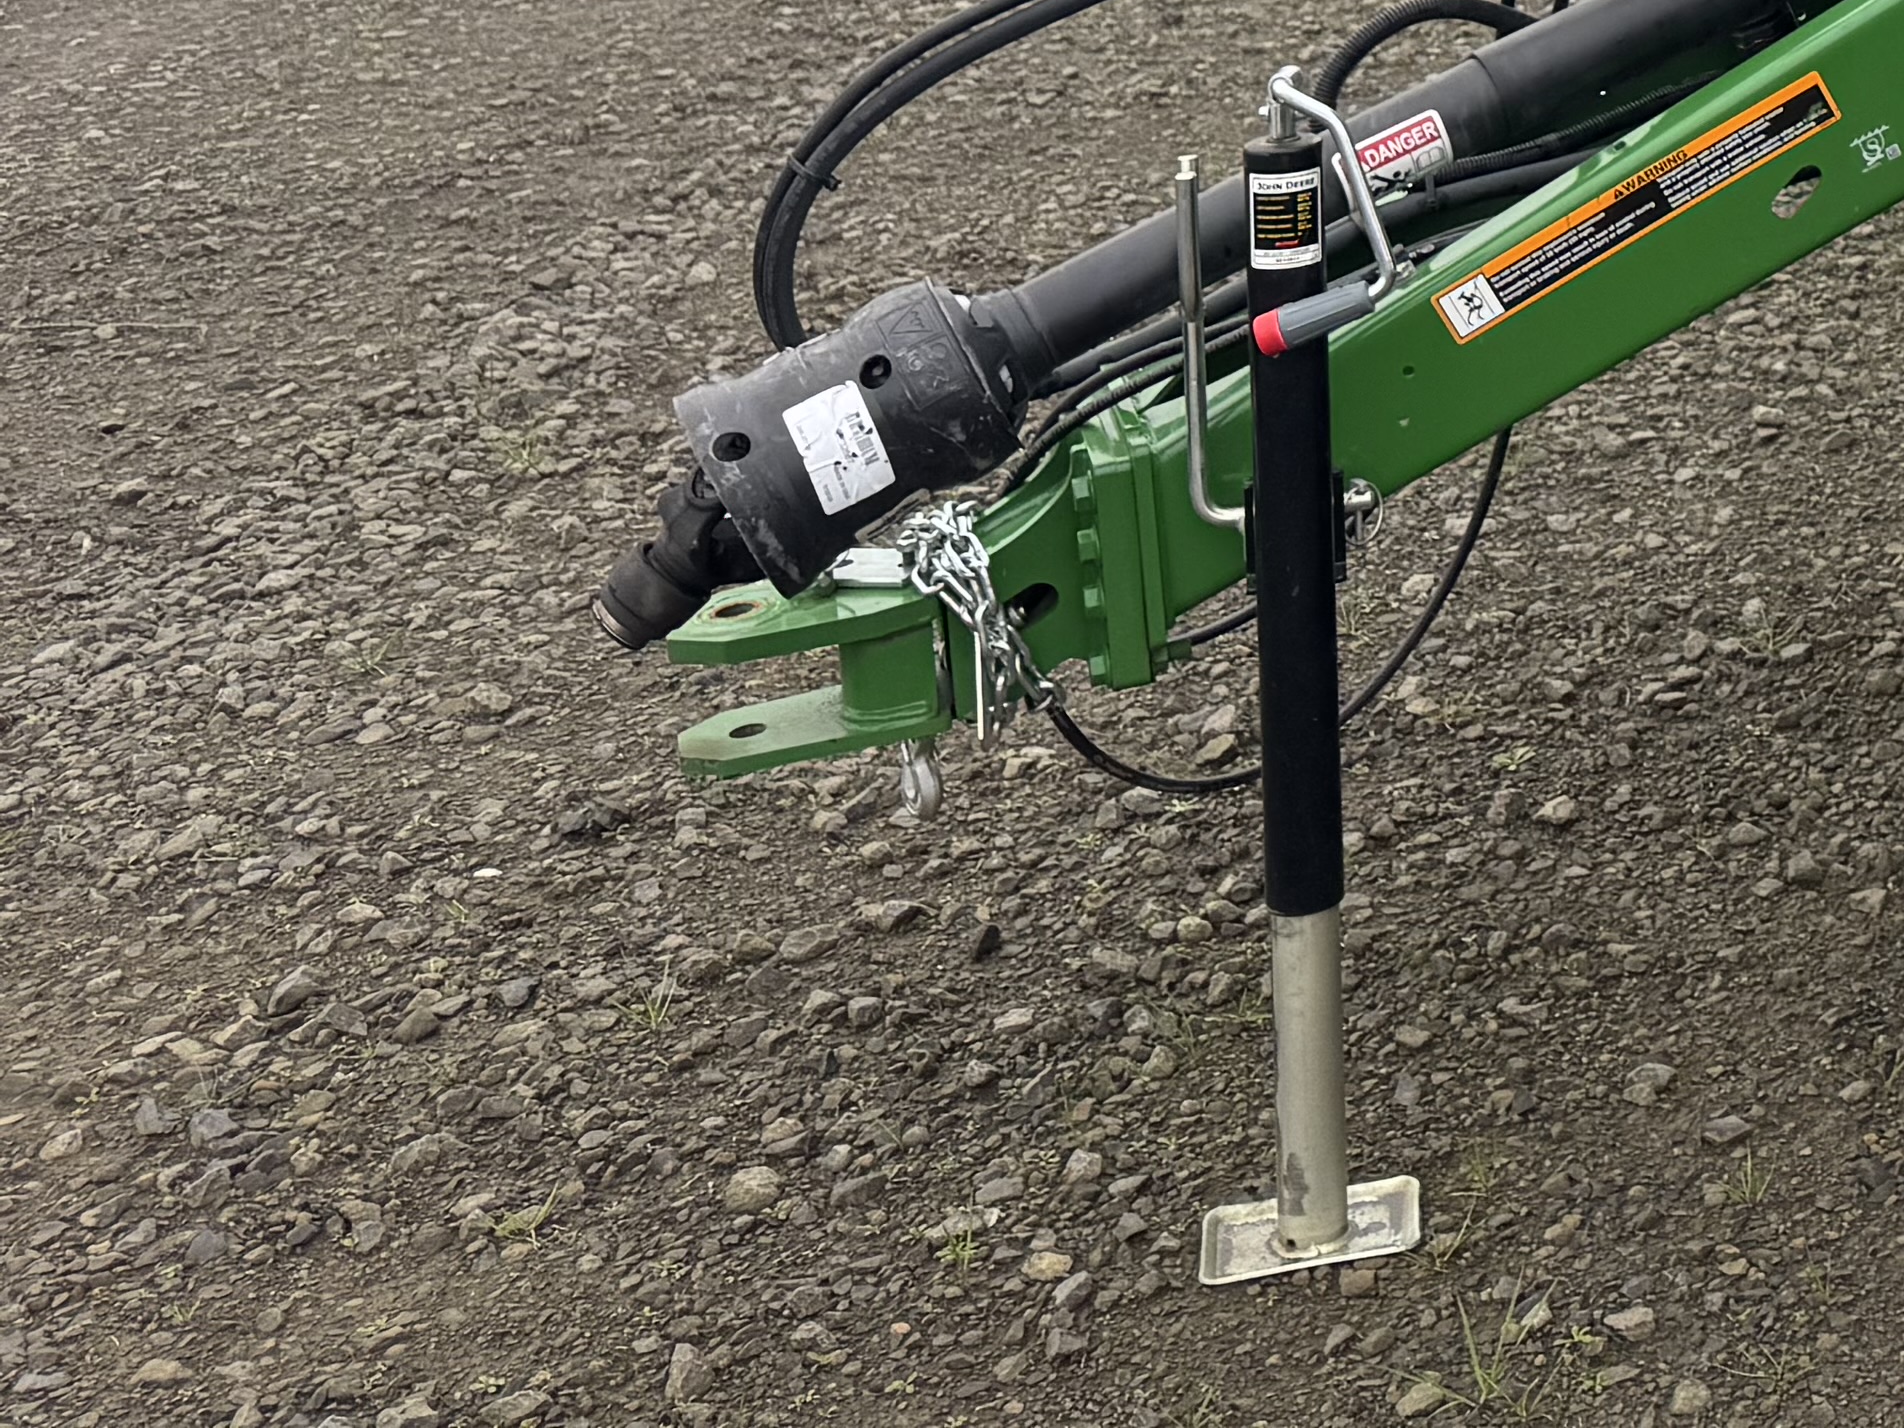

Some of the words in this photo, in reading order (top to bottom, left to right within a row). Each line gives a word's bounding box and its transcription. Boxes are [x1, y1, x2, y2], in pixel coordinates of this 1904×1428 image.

[1364, 121, 1439, 169] DANGER
[1257, 182, 1283, 191] JOHN
[1286, 177, 1316, 190] DEERE
[1621, 149, 1688, 192] WARNING
